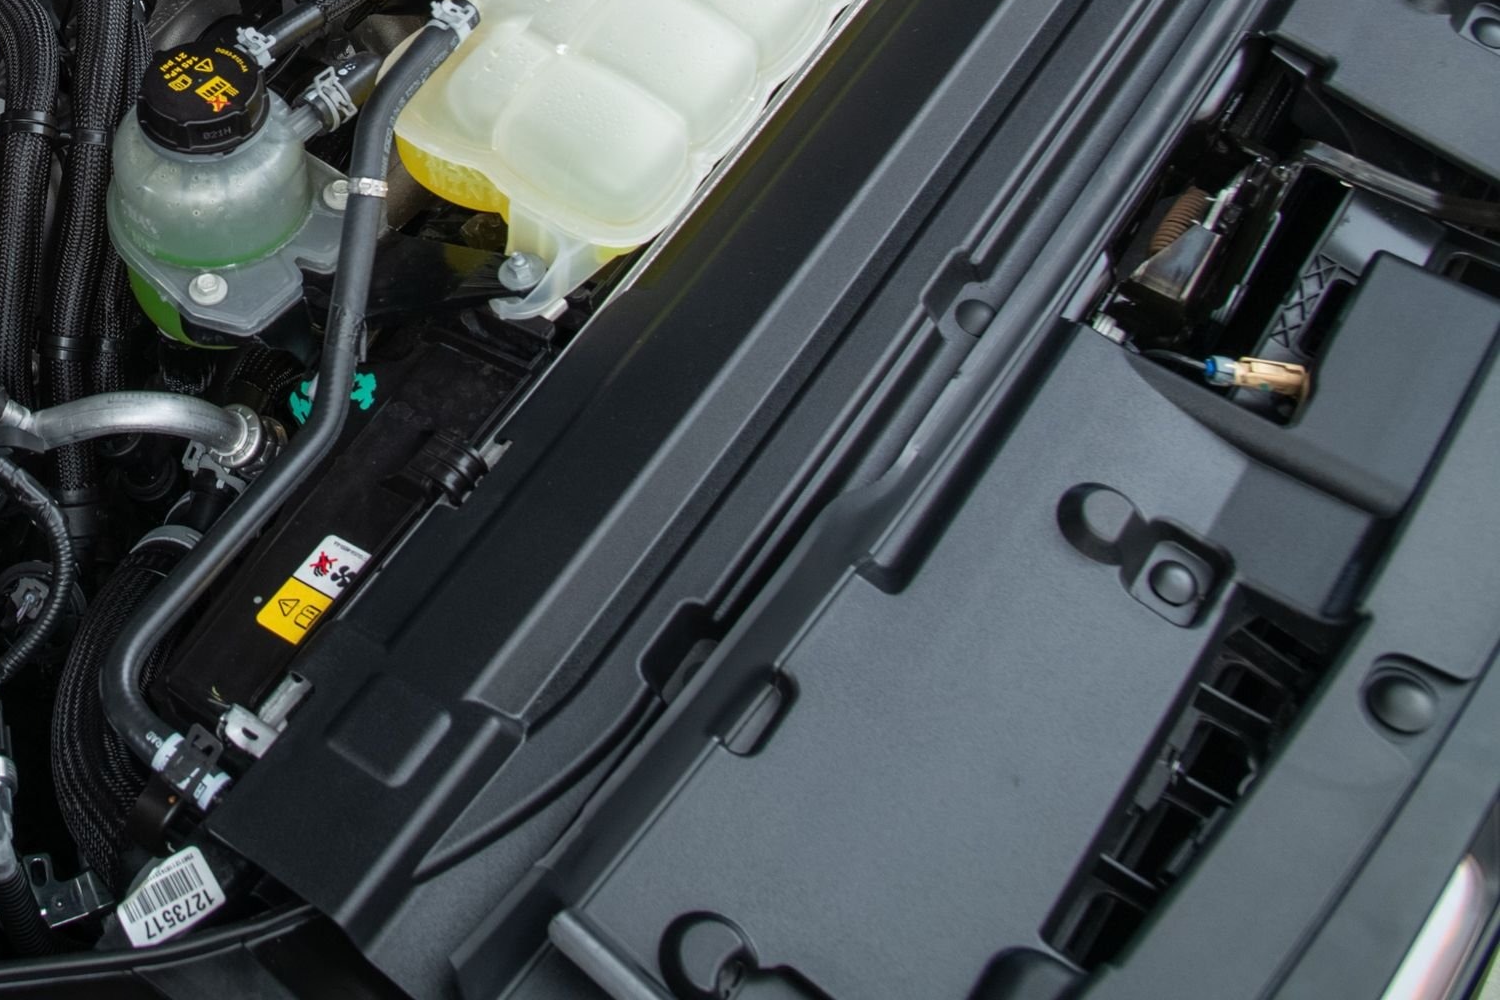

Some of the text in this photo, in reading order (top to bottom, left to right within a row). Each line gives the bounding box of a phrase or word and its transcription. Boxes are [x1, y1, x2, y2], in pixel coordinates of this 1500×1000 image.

[175, 51, 188, 62] 21
[181, 56, 199, 70] 145
[145, 889, 215, 940] 1273517
